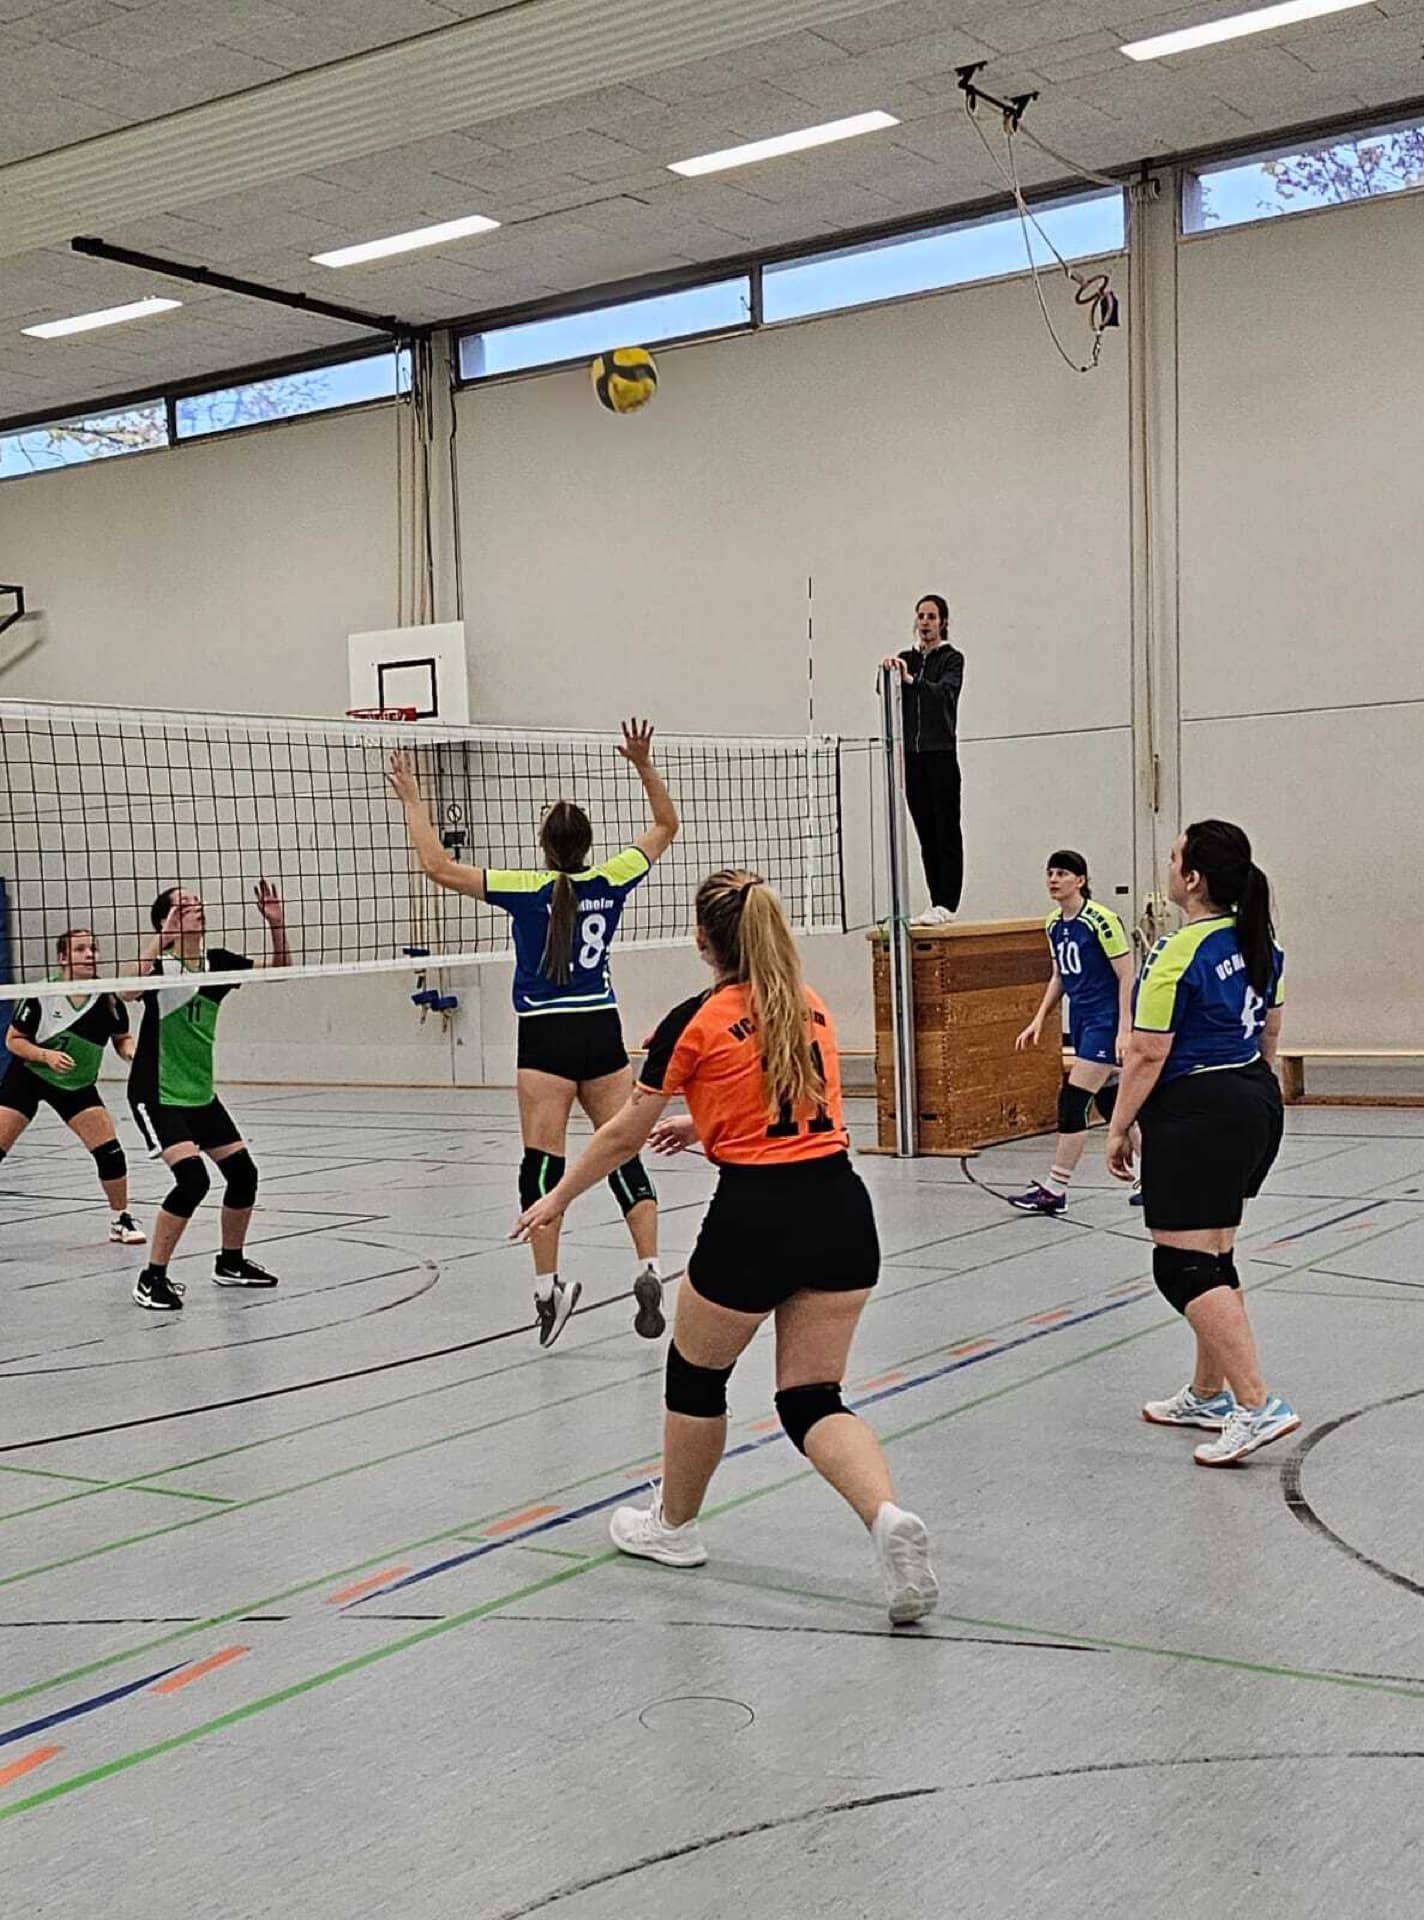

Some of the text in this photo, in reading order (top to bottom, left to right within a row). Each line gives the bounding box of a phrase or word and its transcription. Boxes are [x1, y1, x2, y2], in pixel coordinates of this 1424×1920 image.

[569, 913, 606, 972] 8
[1057, 941, 1082, 975] 10
[761, 1040, 835, 1138] 11
